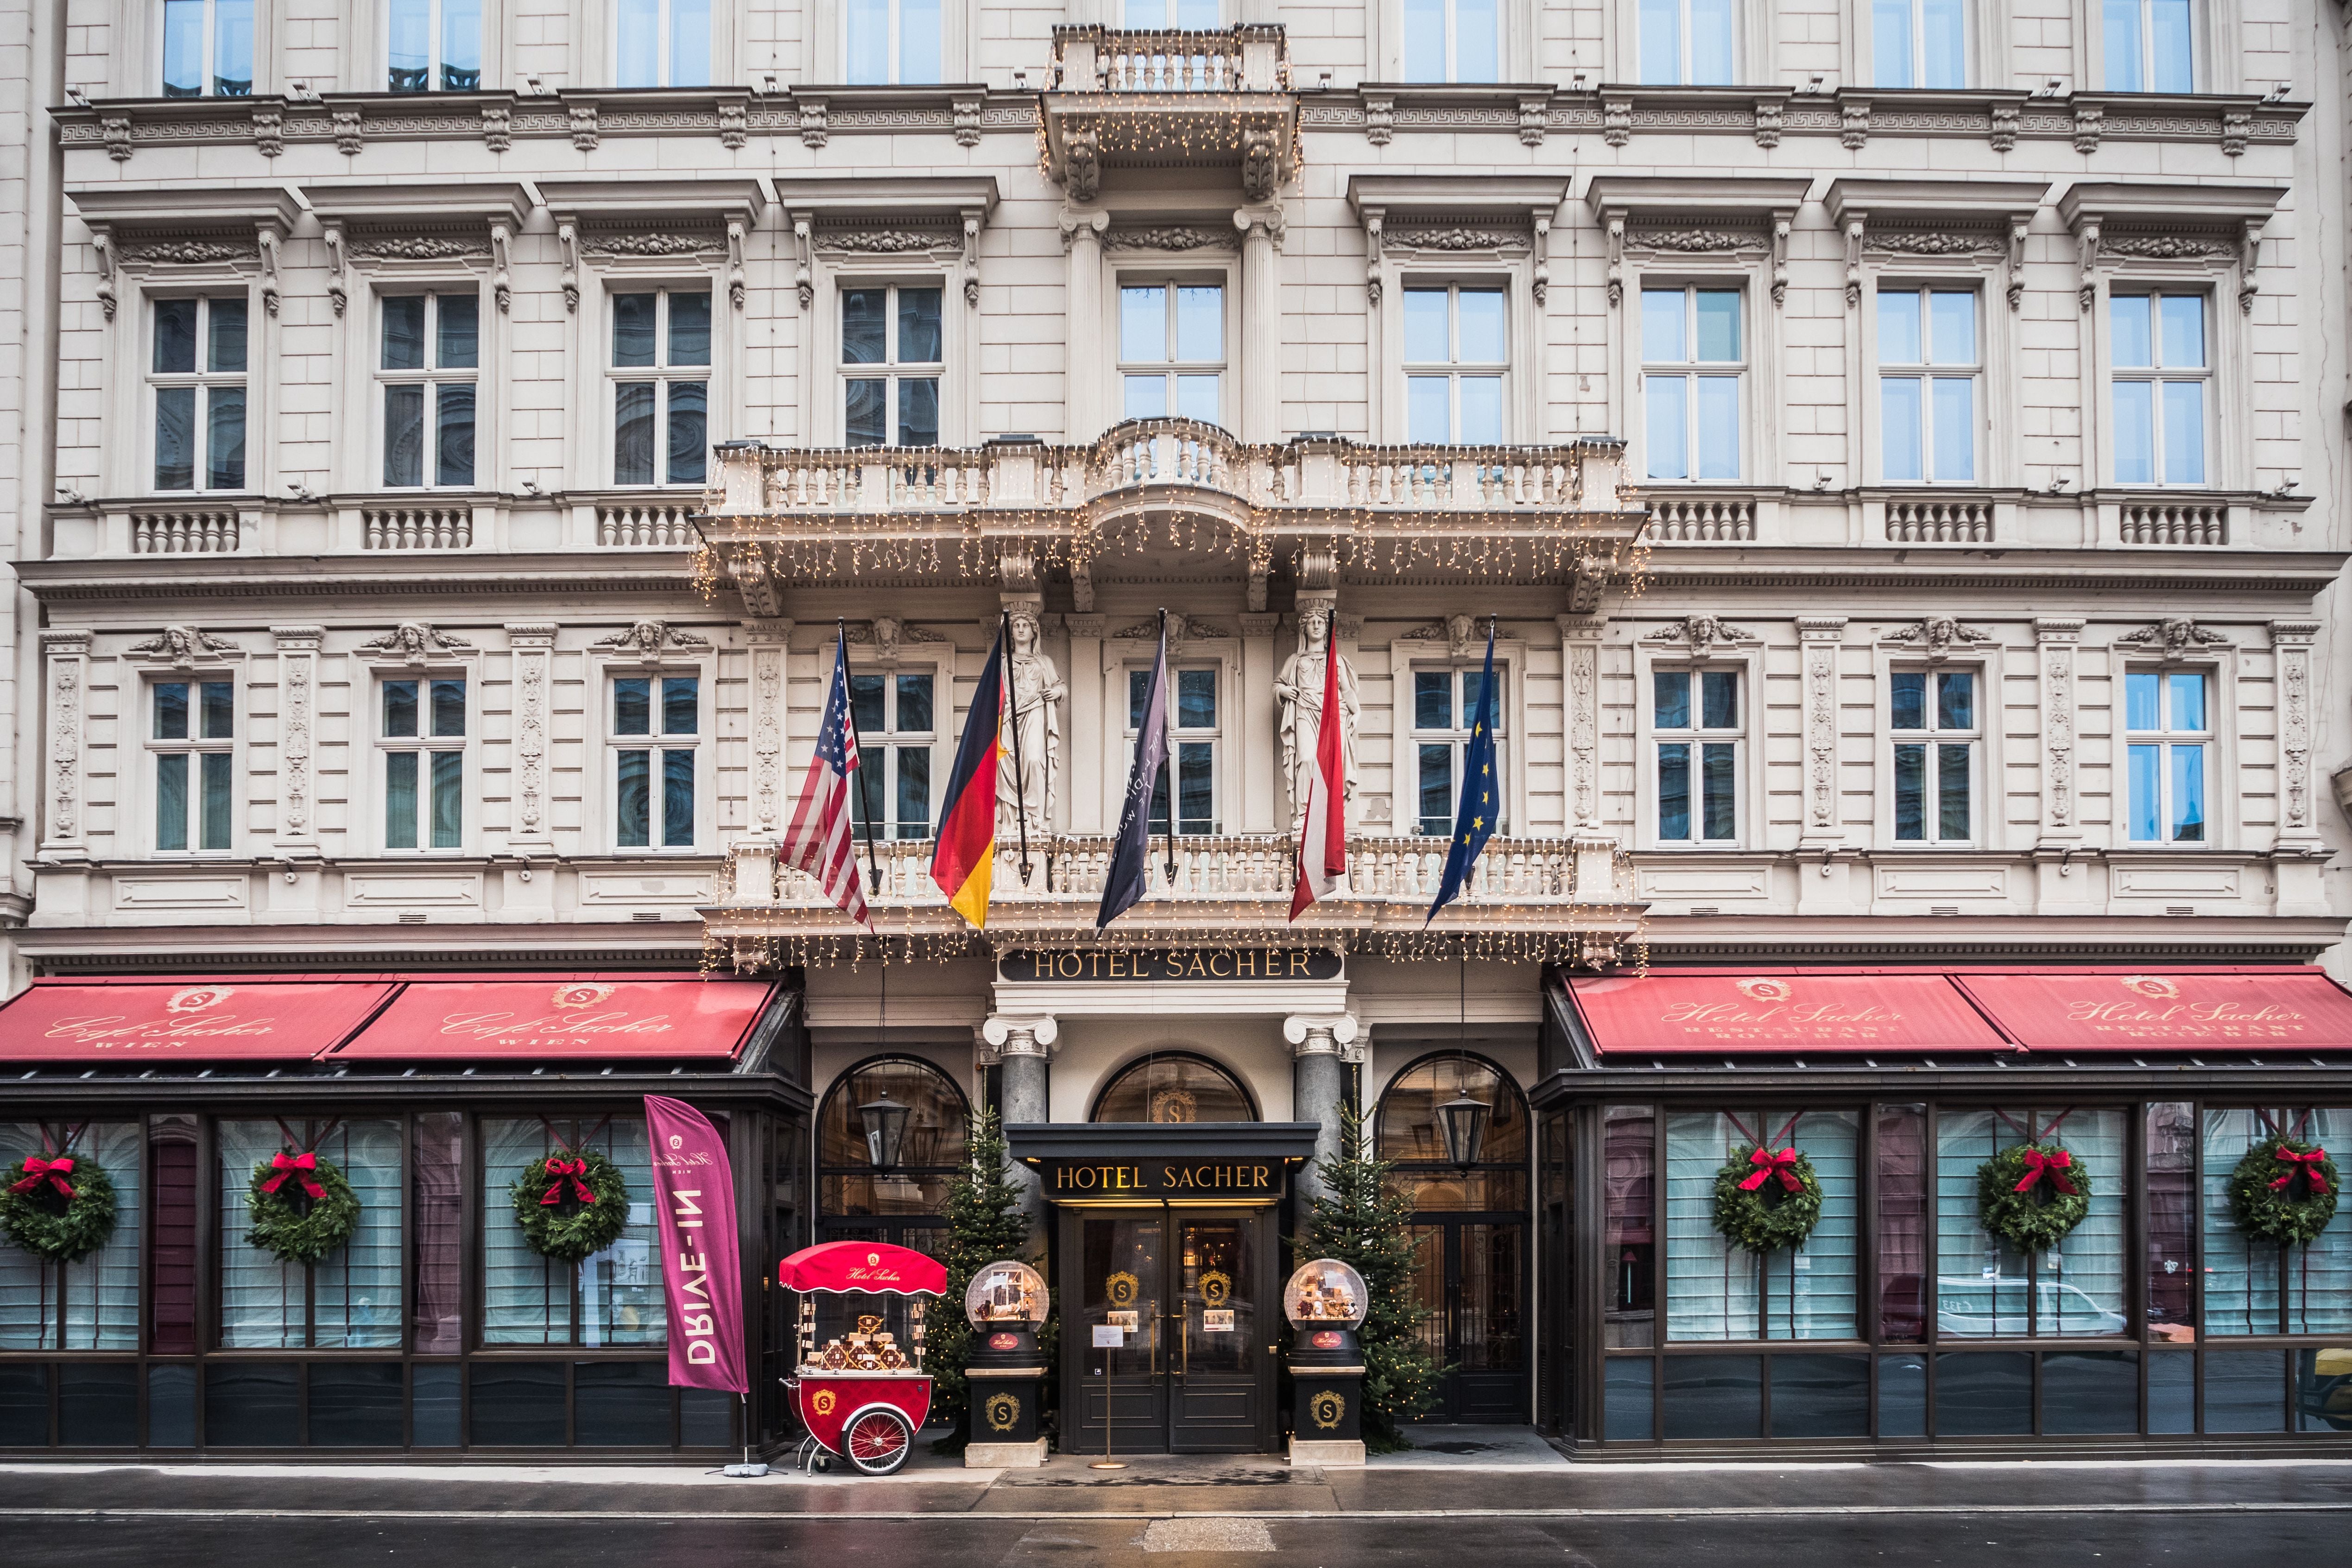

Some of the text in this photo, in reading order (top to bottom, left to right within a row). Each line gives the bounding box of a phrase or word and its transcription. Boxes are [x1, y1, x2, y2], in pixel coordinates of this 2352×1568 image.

[1034, 952, 1311, 977] HOTEL SACHER
[1758, 986, 1774, 995] S
[2144, 983, 2162, 992] S
[186, 994, 209, 1005] S
[570, 991, 591, 1001] S
[1661, 1002, 1906, 1023] Hotel Sacher
[2067, 1001, 2307, 1021] Hotel Sacher
[44, 1015, 275, 1043] Café Sacher
[441, 1012, 675, 1040] Café Sacher
[1169, 1105, 1182, 1123] S
[1057, 1166, 1269, 1189] HOTEL SACHER
[846, 1267, 900, 1281] Hotel Sacher
[1118, 1284, 1127, 1298] S
[1210, 1284, 1220, 1297] S
[821, 1398, 827, 1408] S
[999, 1406, 1007, 1420] S
[1323, 1404, 1332, 1418] S
